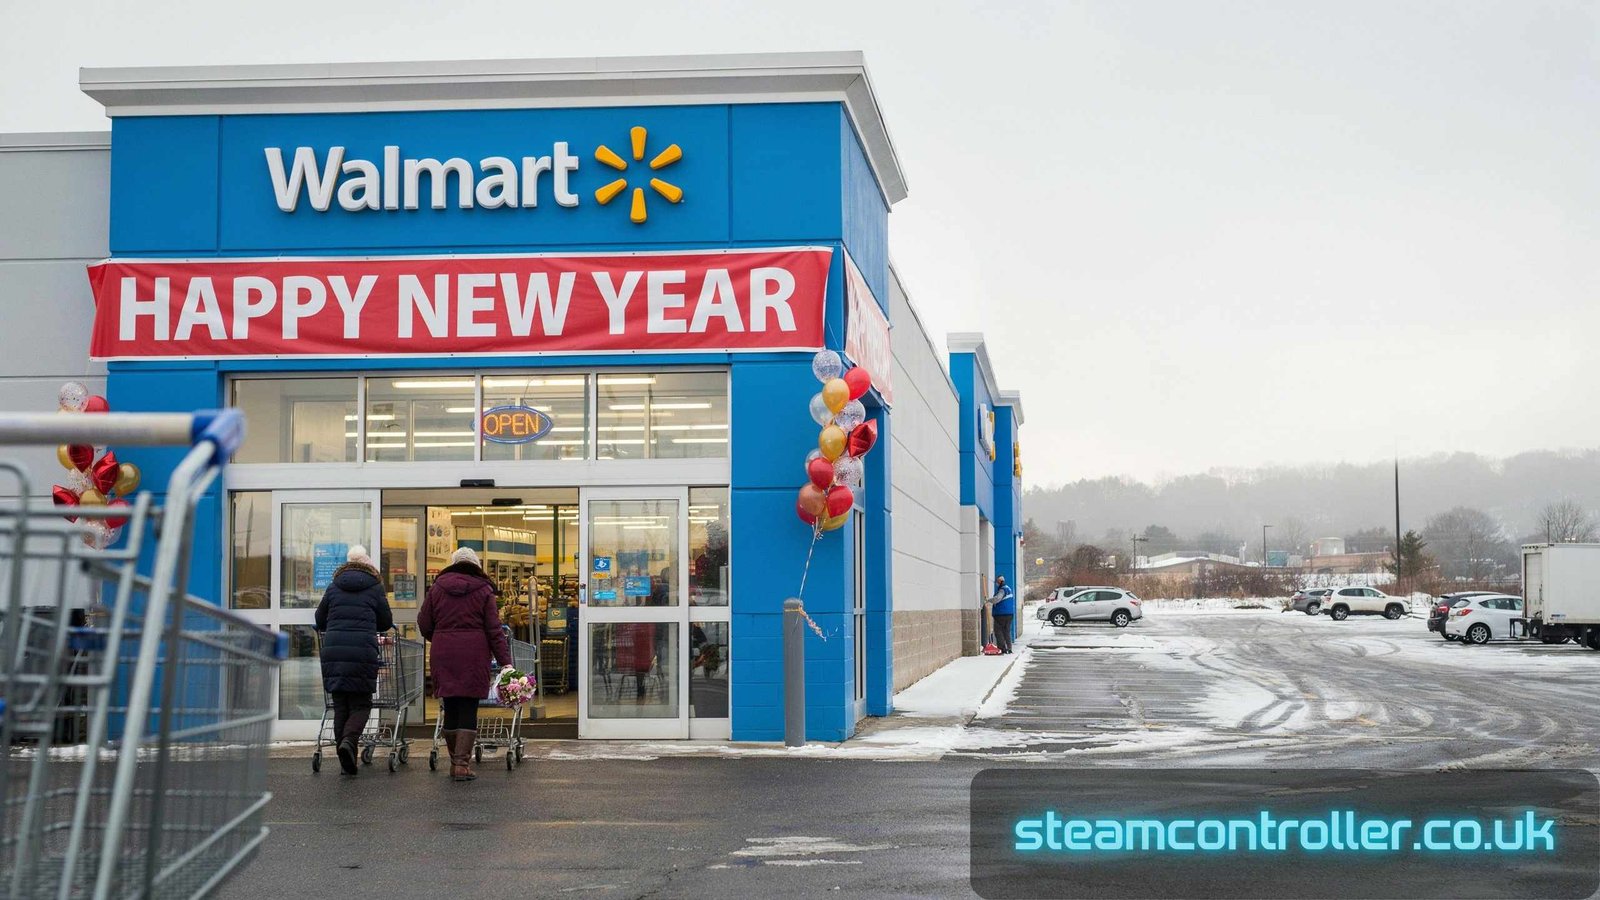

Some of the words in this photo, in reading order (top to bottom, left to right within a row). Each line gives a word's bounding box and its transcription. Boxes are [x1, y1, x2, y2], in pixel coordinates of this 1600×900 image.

[264, 141, 580, 213] Walmart
[119, 275, 379, 341] HAPPY
[397, 271, 577, 339] NEW
[591, 267, 797, 335] YEAR
[483, 413, 539, 436] OPEN
